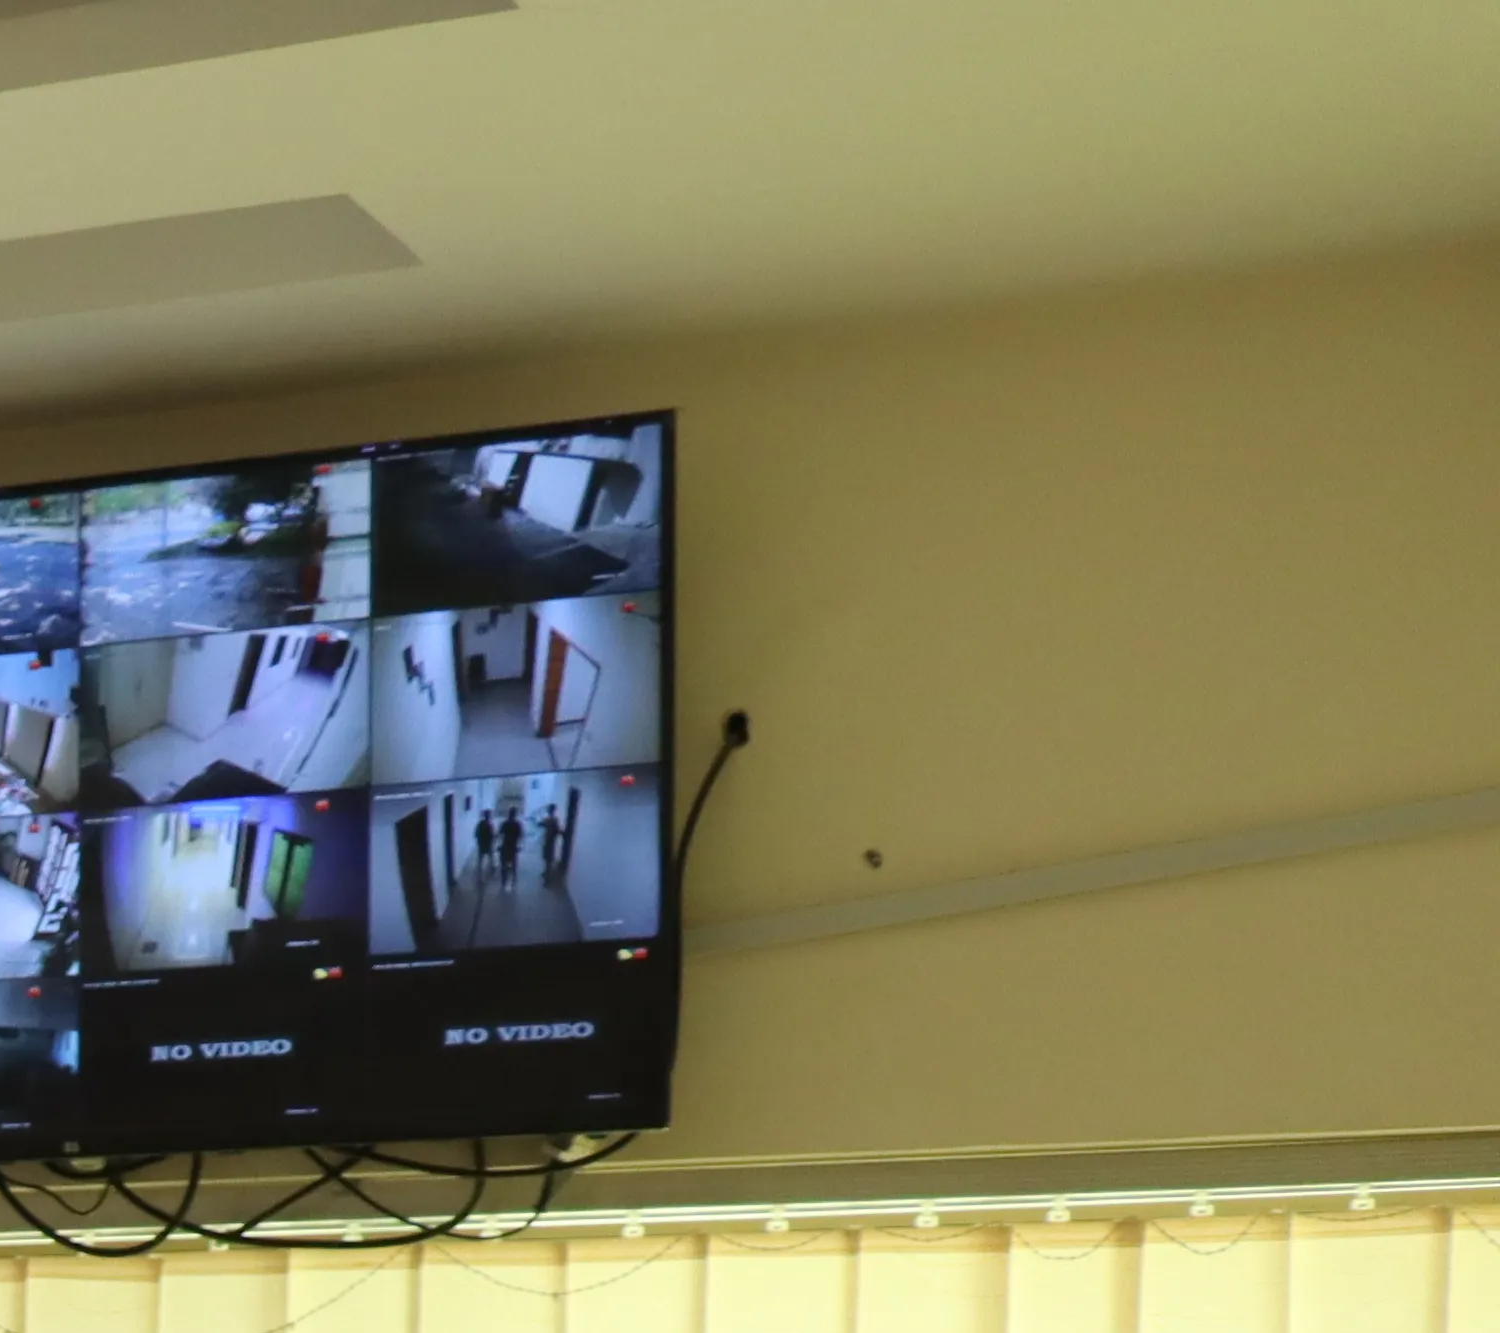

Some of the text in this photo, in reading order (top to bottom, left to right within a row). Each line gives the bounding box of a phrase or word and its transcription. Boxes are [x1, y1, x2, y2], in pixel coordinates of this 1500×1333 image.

[444, 1021, 595, 1046] NO VIDEO
[150, 1038, 293, 1062] NO VIDEO
